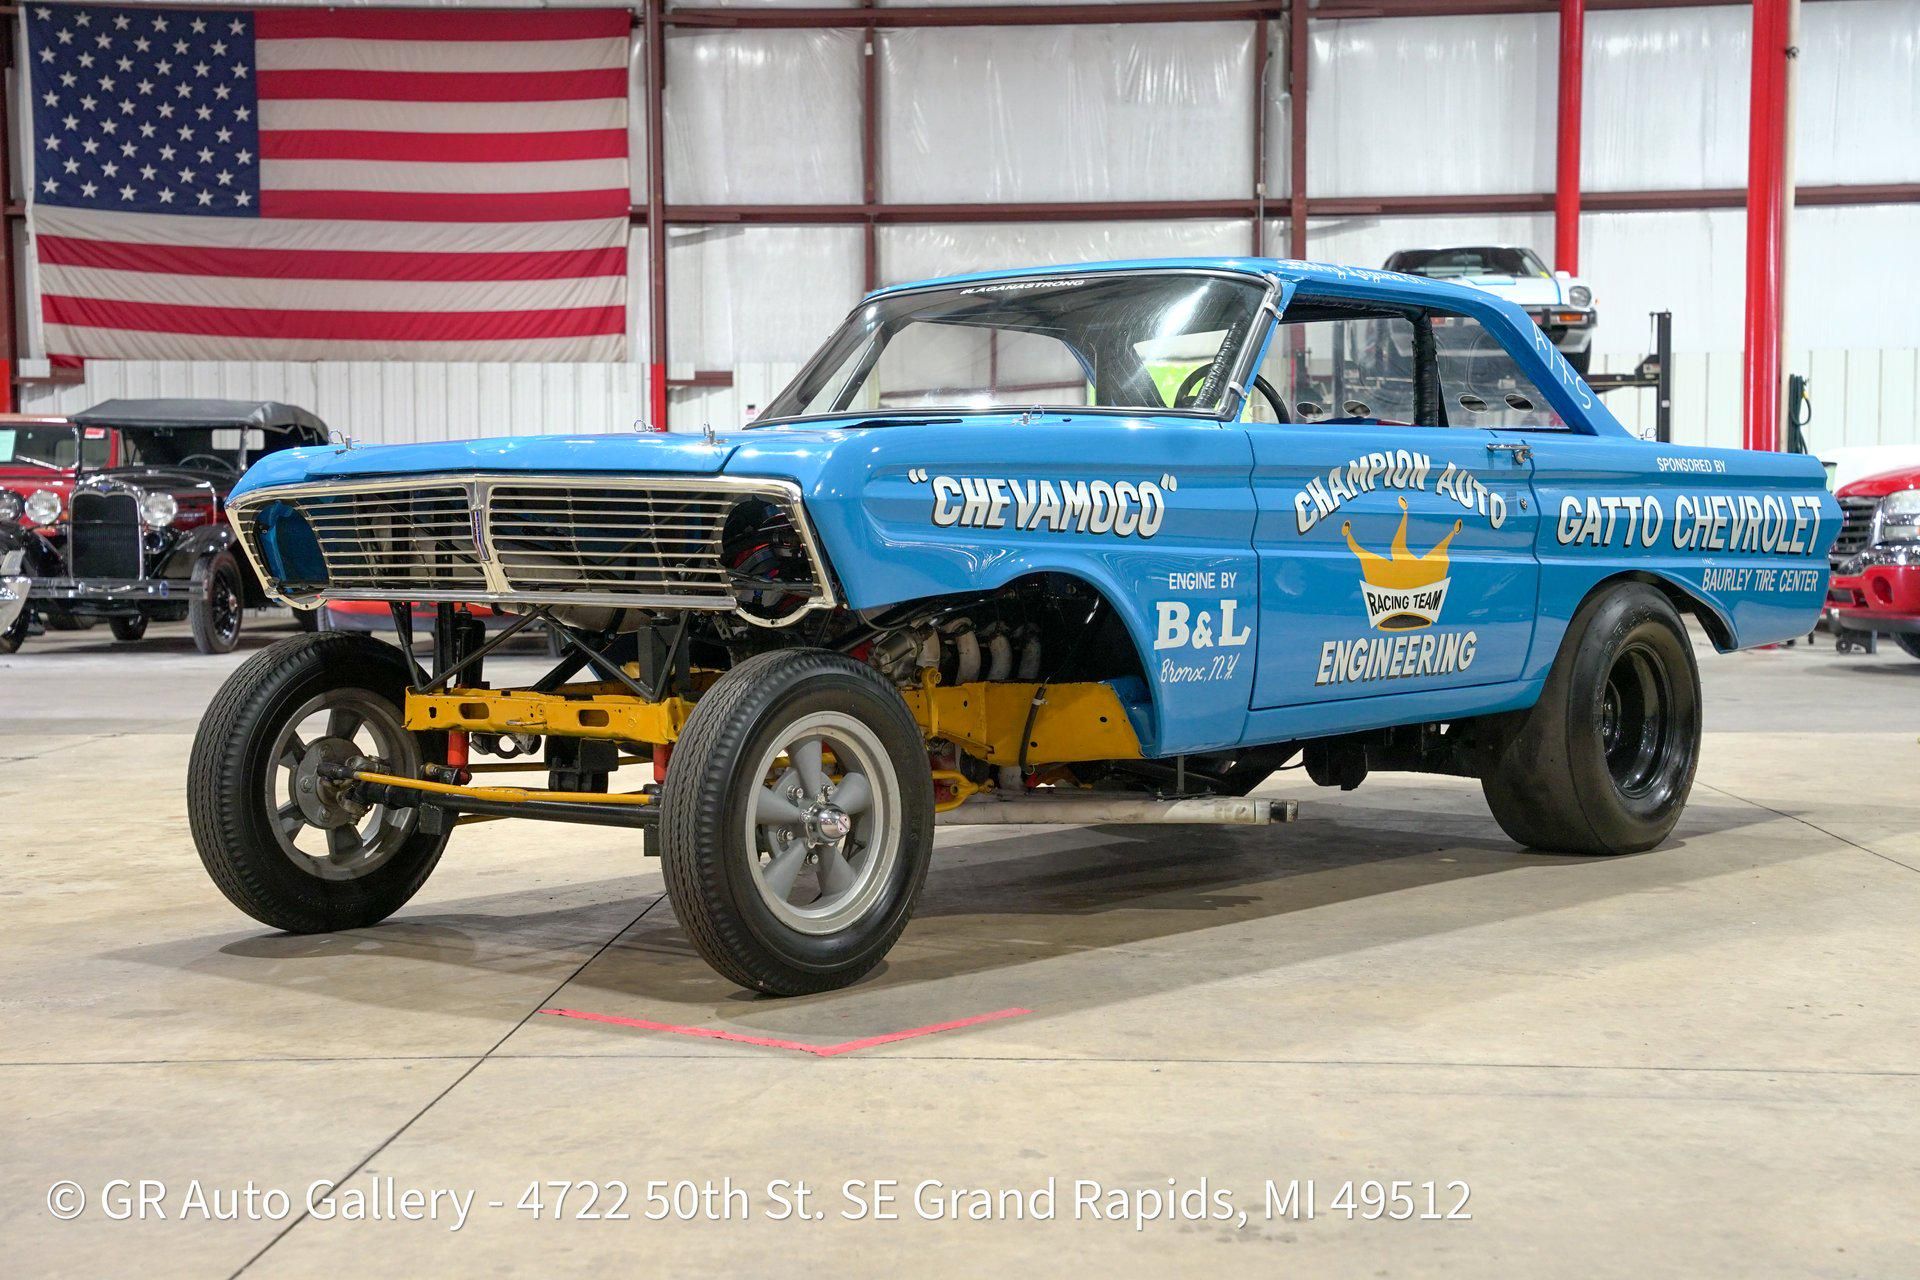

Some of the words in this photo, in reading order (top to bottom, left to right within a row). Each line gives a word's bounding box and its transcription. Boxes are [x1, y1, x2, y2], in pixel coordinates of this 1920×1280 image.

[960, 280, 1085, 295] #LAGANASTRONG
[1656, 456, 1713, 473] SPONSORED
[1714, 459, 1727, 473] BY
[1294, 448, 1431, 535] CHAMPION
[1436, 461, 1507, 529] AUTO
[1557, 494, 1664, 548] GATTO
[1673, 494, 1823, 556] CHEVROLET
[1169, 572, 1216, 590] ENGINE
[1221, 572, 1237, 589] BY
[1702, 567, 1753, 592] BAURLEY
[1754, 568, 1778, 592] TIRE
[1779, 570, 1819, 593] CENTER
[1366, 591, 1410, 617] RACING
[1412, 589, 1443, 611] TEAM
[1153, 599, 1252, 650] B&L
[1160, 658, 1206, 683] Bronx,
[1314, 630, 1478, 687] ENGINEERING
